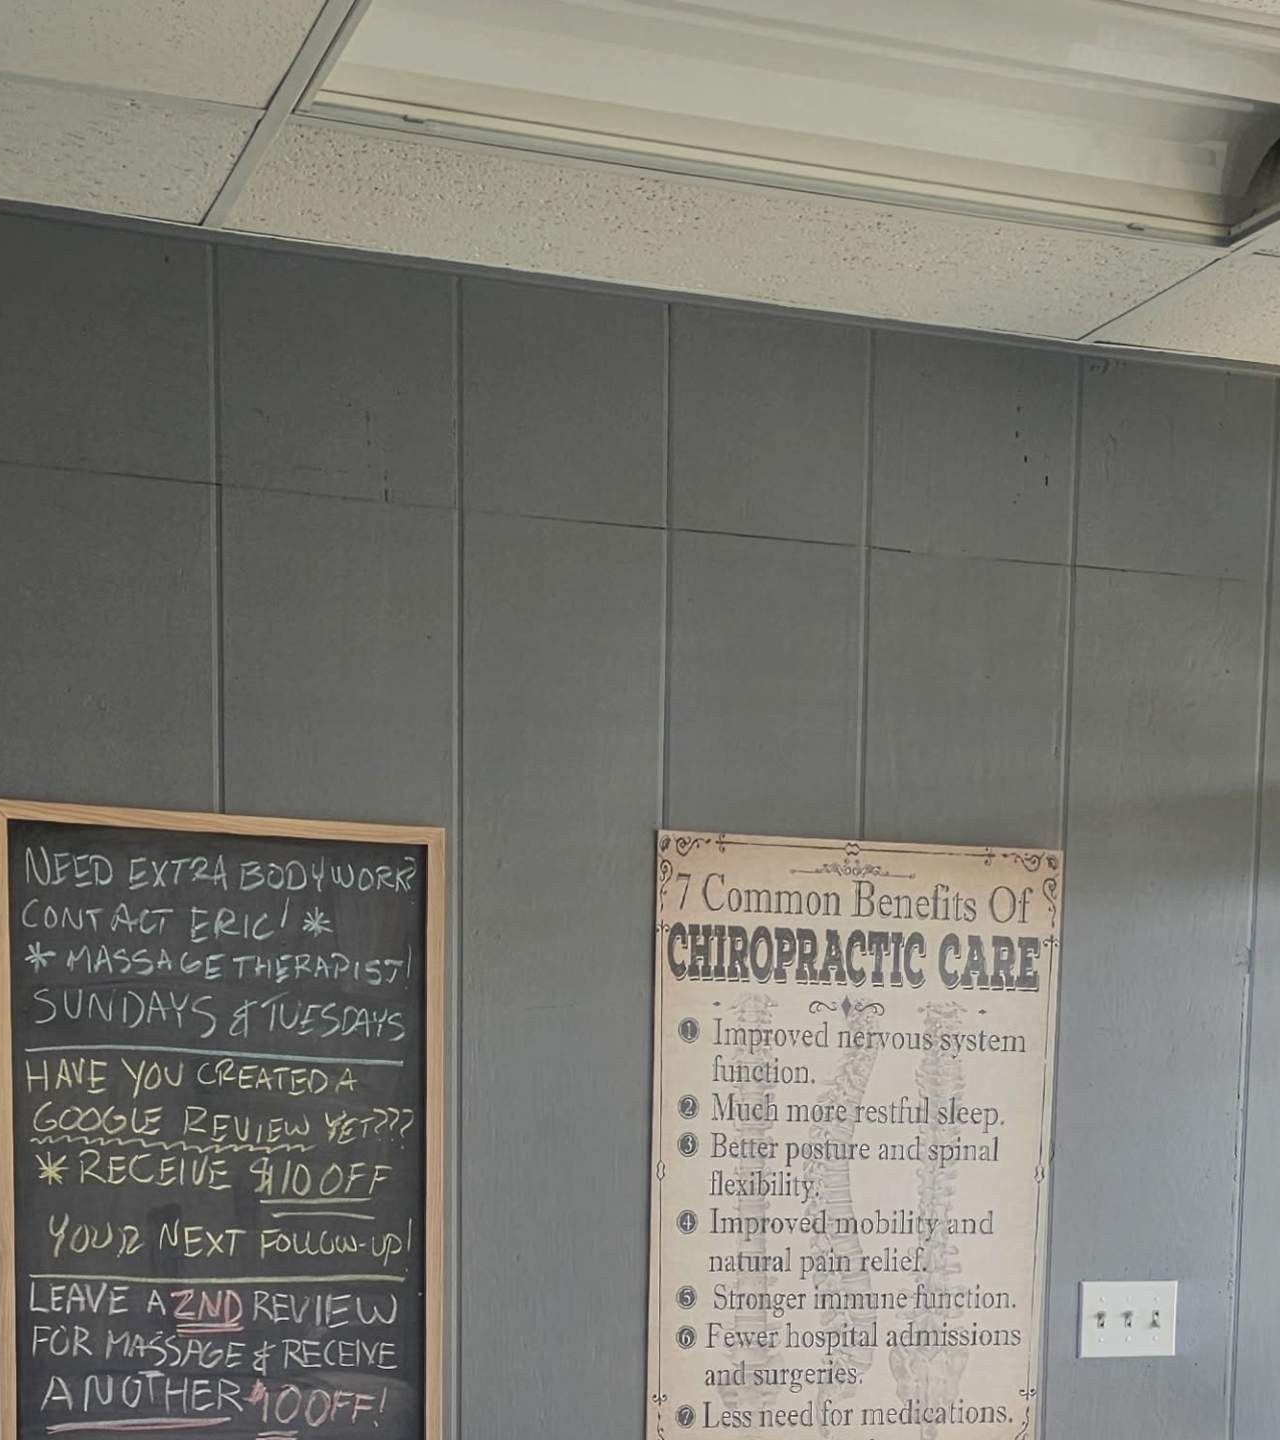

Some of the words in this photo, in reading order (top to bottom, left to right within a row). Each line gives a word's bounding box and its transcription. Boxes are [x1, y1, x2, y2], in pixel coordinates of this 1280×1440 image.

[25, 845, 113, 888] NEED
[129, 856, 229, 889] EXTRA
[21, 899, 174, 934] CONTACT
[675, 872, 691, 910] 7
[701, 871, 841, 918] Common
[850, 879, 978, 924] Benefits
[987, 884, 1034, 925] Of
[66, 947, 225, 981] MASSAGE
[233, 945, 412, 989] THERAPIST!
[666, 918, 927, 990] CHIROPRACTIC
[937, 932, 1041, 993] CARE
[33, 988, 217, 1039] SUNDAYS
[229, 998, 256, 1039] &
[261, 992, 406, 1041] TUESDAYS
[712, 1017, 828, 1056] Improved
[837, 1028, 933, 1050] nervous
[938, 1030, 1026, 1061] system
[25, 1057, 108, 1095] HAVE
[122, 1058, 183, 1098] YOU
[197, 1059, 327, 1096] CREATED
[333, 1067, 358, 1093] A
[711, 1054, 815, 1084] function.
[33, 1101, 162, 1136] GOOGLE
[184, 1107, 310, 1142] REVIEW
[711, 1092, 778, 1122] Much
[786, 1103, 847, 1123] more
[855, 1096, 929, 1125] restful
[936, 1098, 1005, 1133] sleep.
[710, 1132, 779, 1159] Better
[785, 1135, 870, 1165] posture
[877, 1134, 922, 1161] and
[927, 1133, 999, 1169] spinal
[79, 1150, 232, 1189] RECEIVE
[249, 1157, 311, 1197] $10
[319, 1163, 393, 1196] OFF
[709, 1169, 820, 1203] flexibility.
[49, 1213, 144, 1258] YOUR
[159, 1218, 247, 1257] NEXT
[709, 1207, 826, 1242] Improved
[834, 1208, 939, 1240] mobility
[947, 1209, 994, 1234] and
[708, 1246, 792, 1273] natural
[799, 1246, 850, 1280] pain
[859, 1245, 927, 1272] relief.
[29, 1281, 130, 1314] LEAVE
[147, 1289, 166, 1313] A
[171, 1289, 243, 1324] 2ND
[253, 1290, 398, 1329] REVIEW
[712, 1283, 805, 1318] Stronger
[813, 1286, 907, 1310] immune
[913, 1283, 1017, 1310] function.
[32, 1326, 93, 1358] FOR
[106, 1331, 247, 1369] MASSAGE
[252, 1341, 277, 1375] &
[284, 1340, 398, 1370] RECEIVE
[704, 1321, 778, 1349] Fewer
[785, 1320, 878, 1355] hospital
[885, 1320, 1021, 1349] admissions
[41, 1371, 243, 1412] ANOTHER
[704, 1361, 745, 1386] and
[753, 1360, 863, 1393] surgeries.
[702, 1400, 751, 1428] Less
[759, 1401, 813, 1426] need
[822, 1399, 852, 1425] for
[860, 1399, 1014, 1426] medications.
